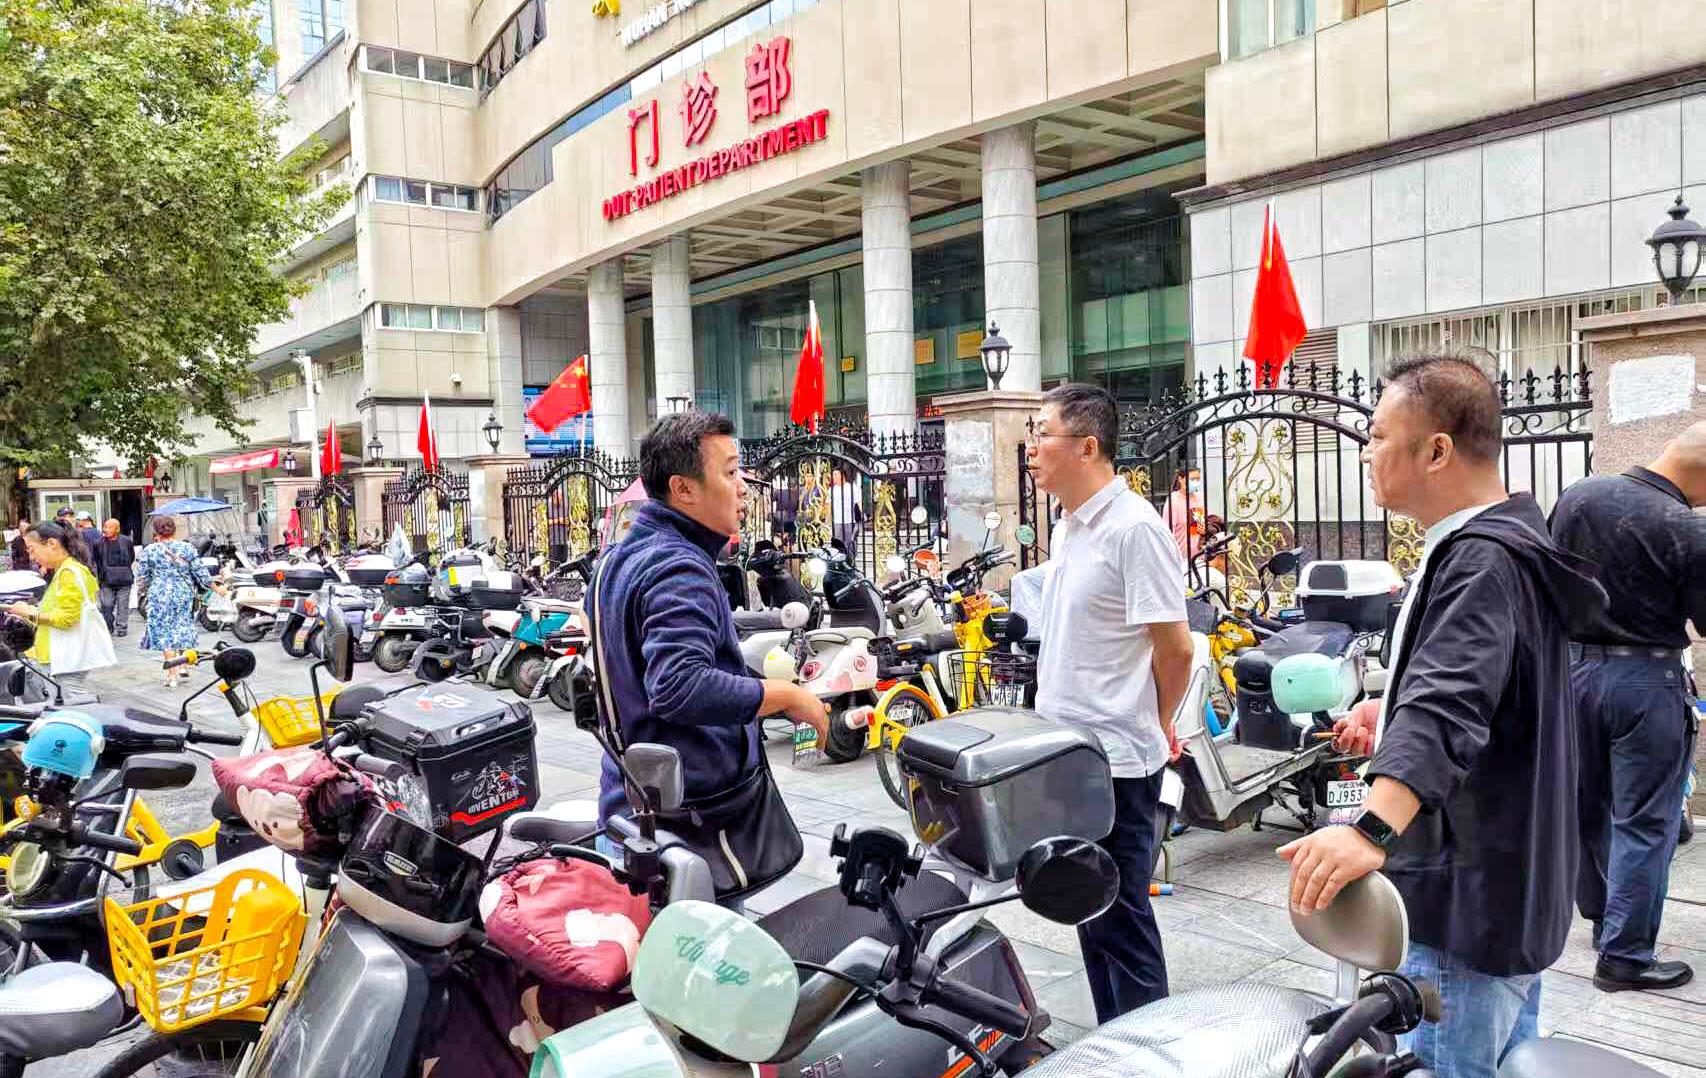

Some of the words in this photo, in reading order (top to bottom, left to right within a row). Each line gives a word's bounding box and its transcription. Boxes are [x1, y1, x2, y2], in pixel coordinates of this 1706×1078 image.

[627, 35, 791, 177] 门诊部
[697, 109, 830, 182] DEPARTMENT
